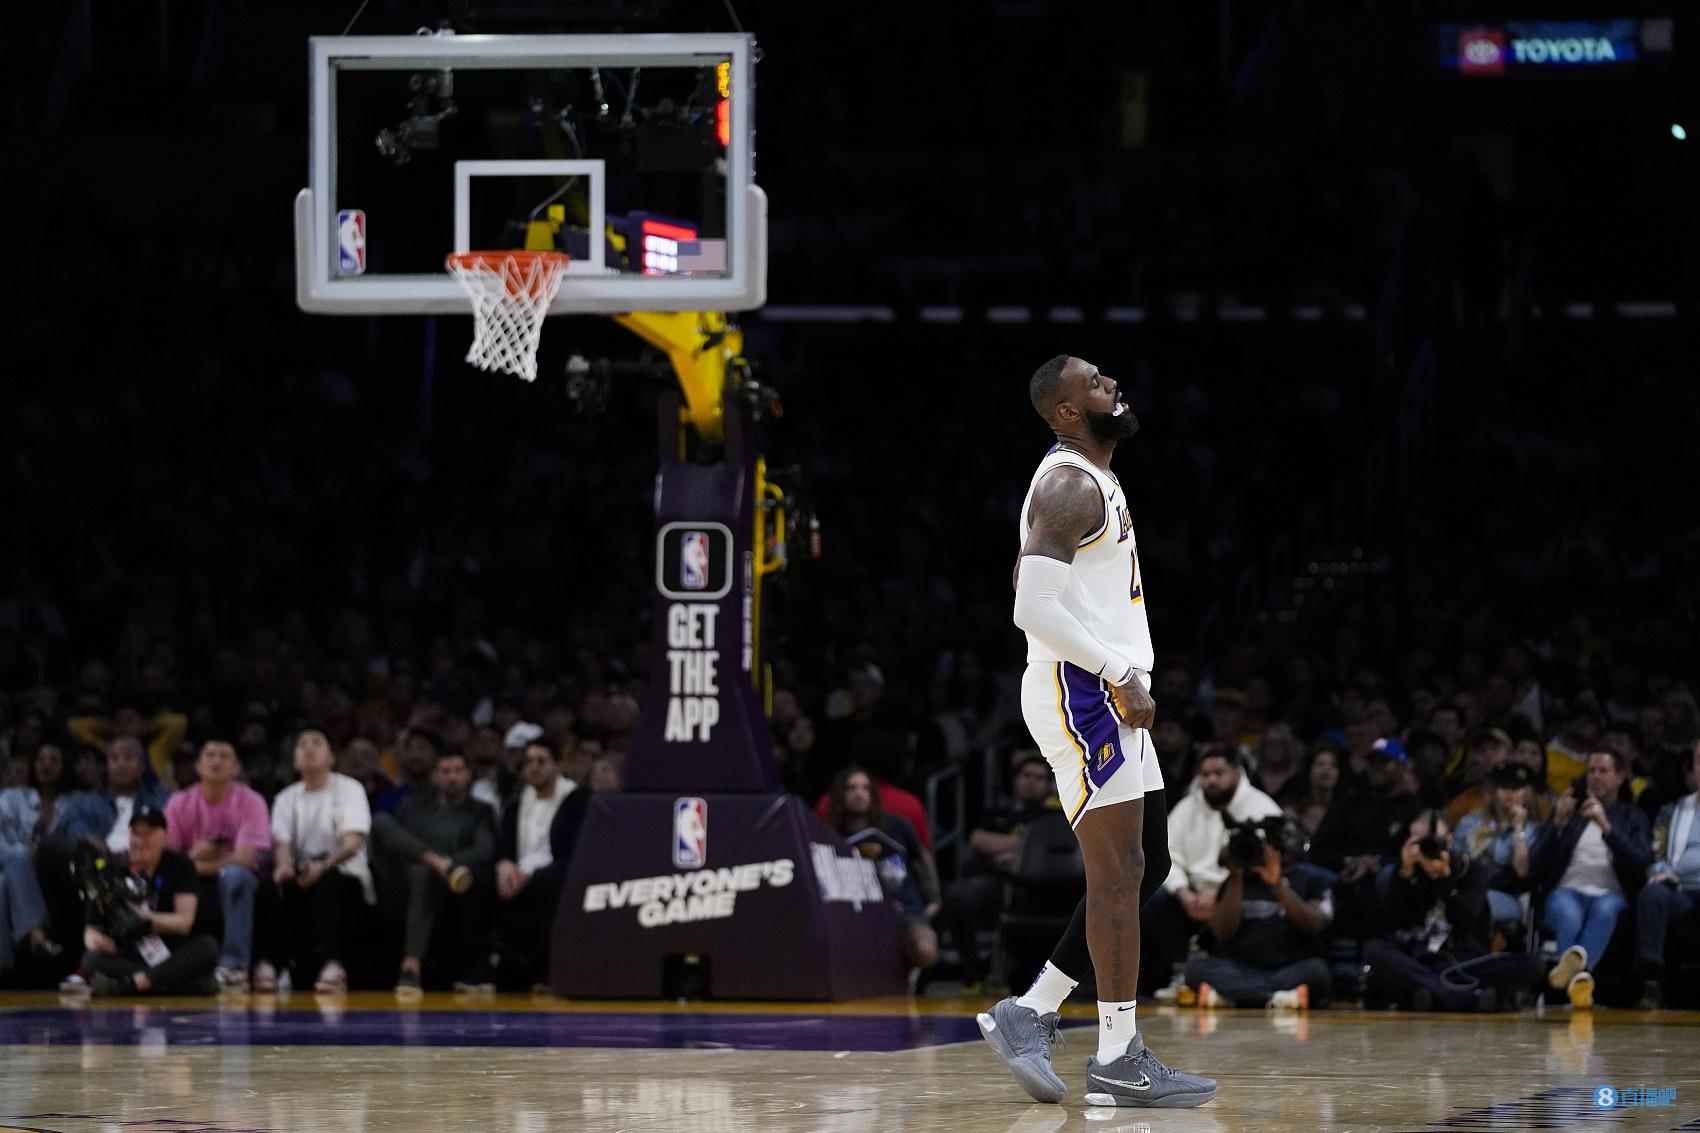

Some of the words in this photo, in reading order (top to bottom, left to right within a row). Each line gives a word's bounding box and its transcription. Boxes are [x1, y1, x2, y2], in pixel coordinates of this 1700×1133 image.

[1513, 37, 1616, 63] TOYOTA
[667, 603, 720, 649] GET
[666, 650, 720, 696] THE
[664, 697, 719, 742] APP
[583, 858, 795, 912] EVERYONE'S
[637, 890, 737, 928] GAME
